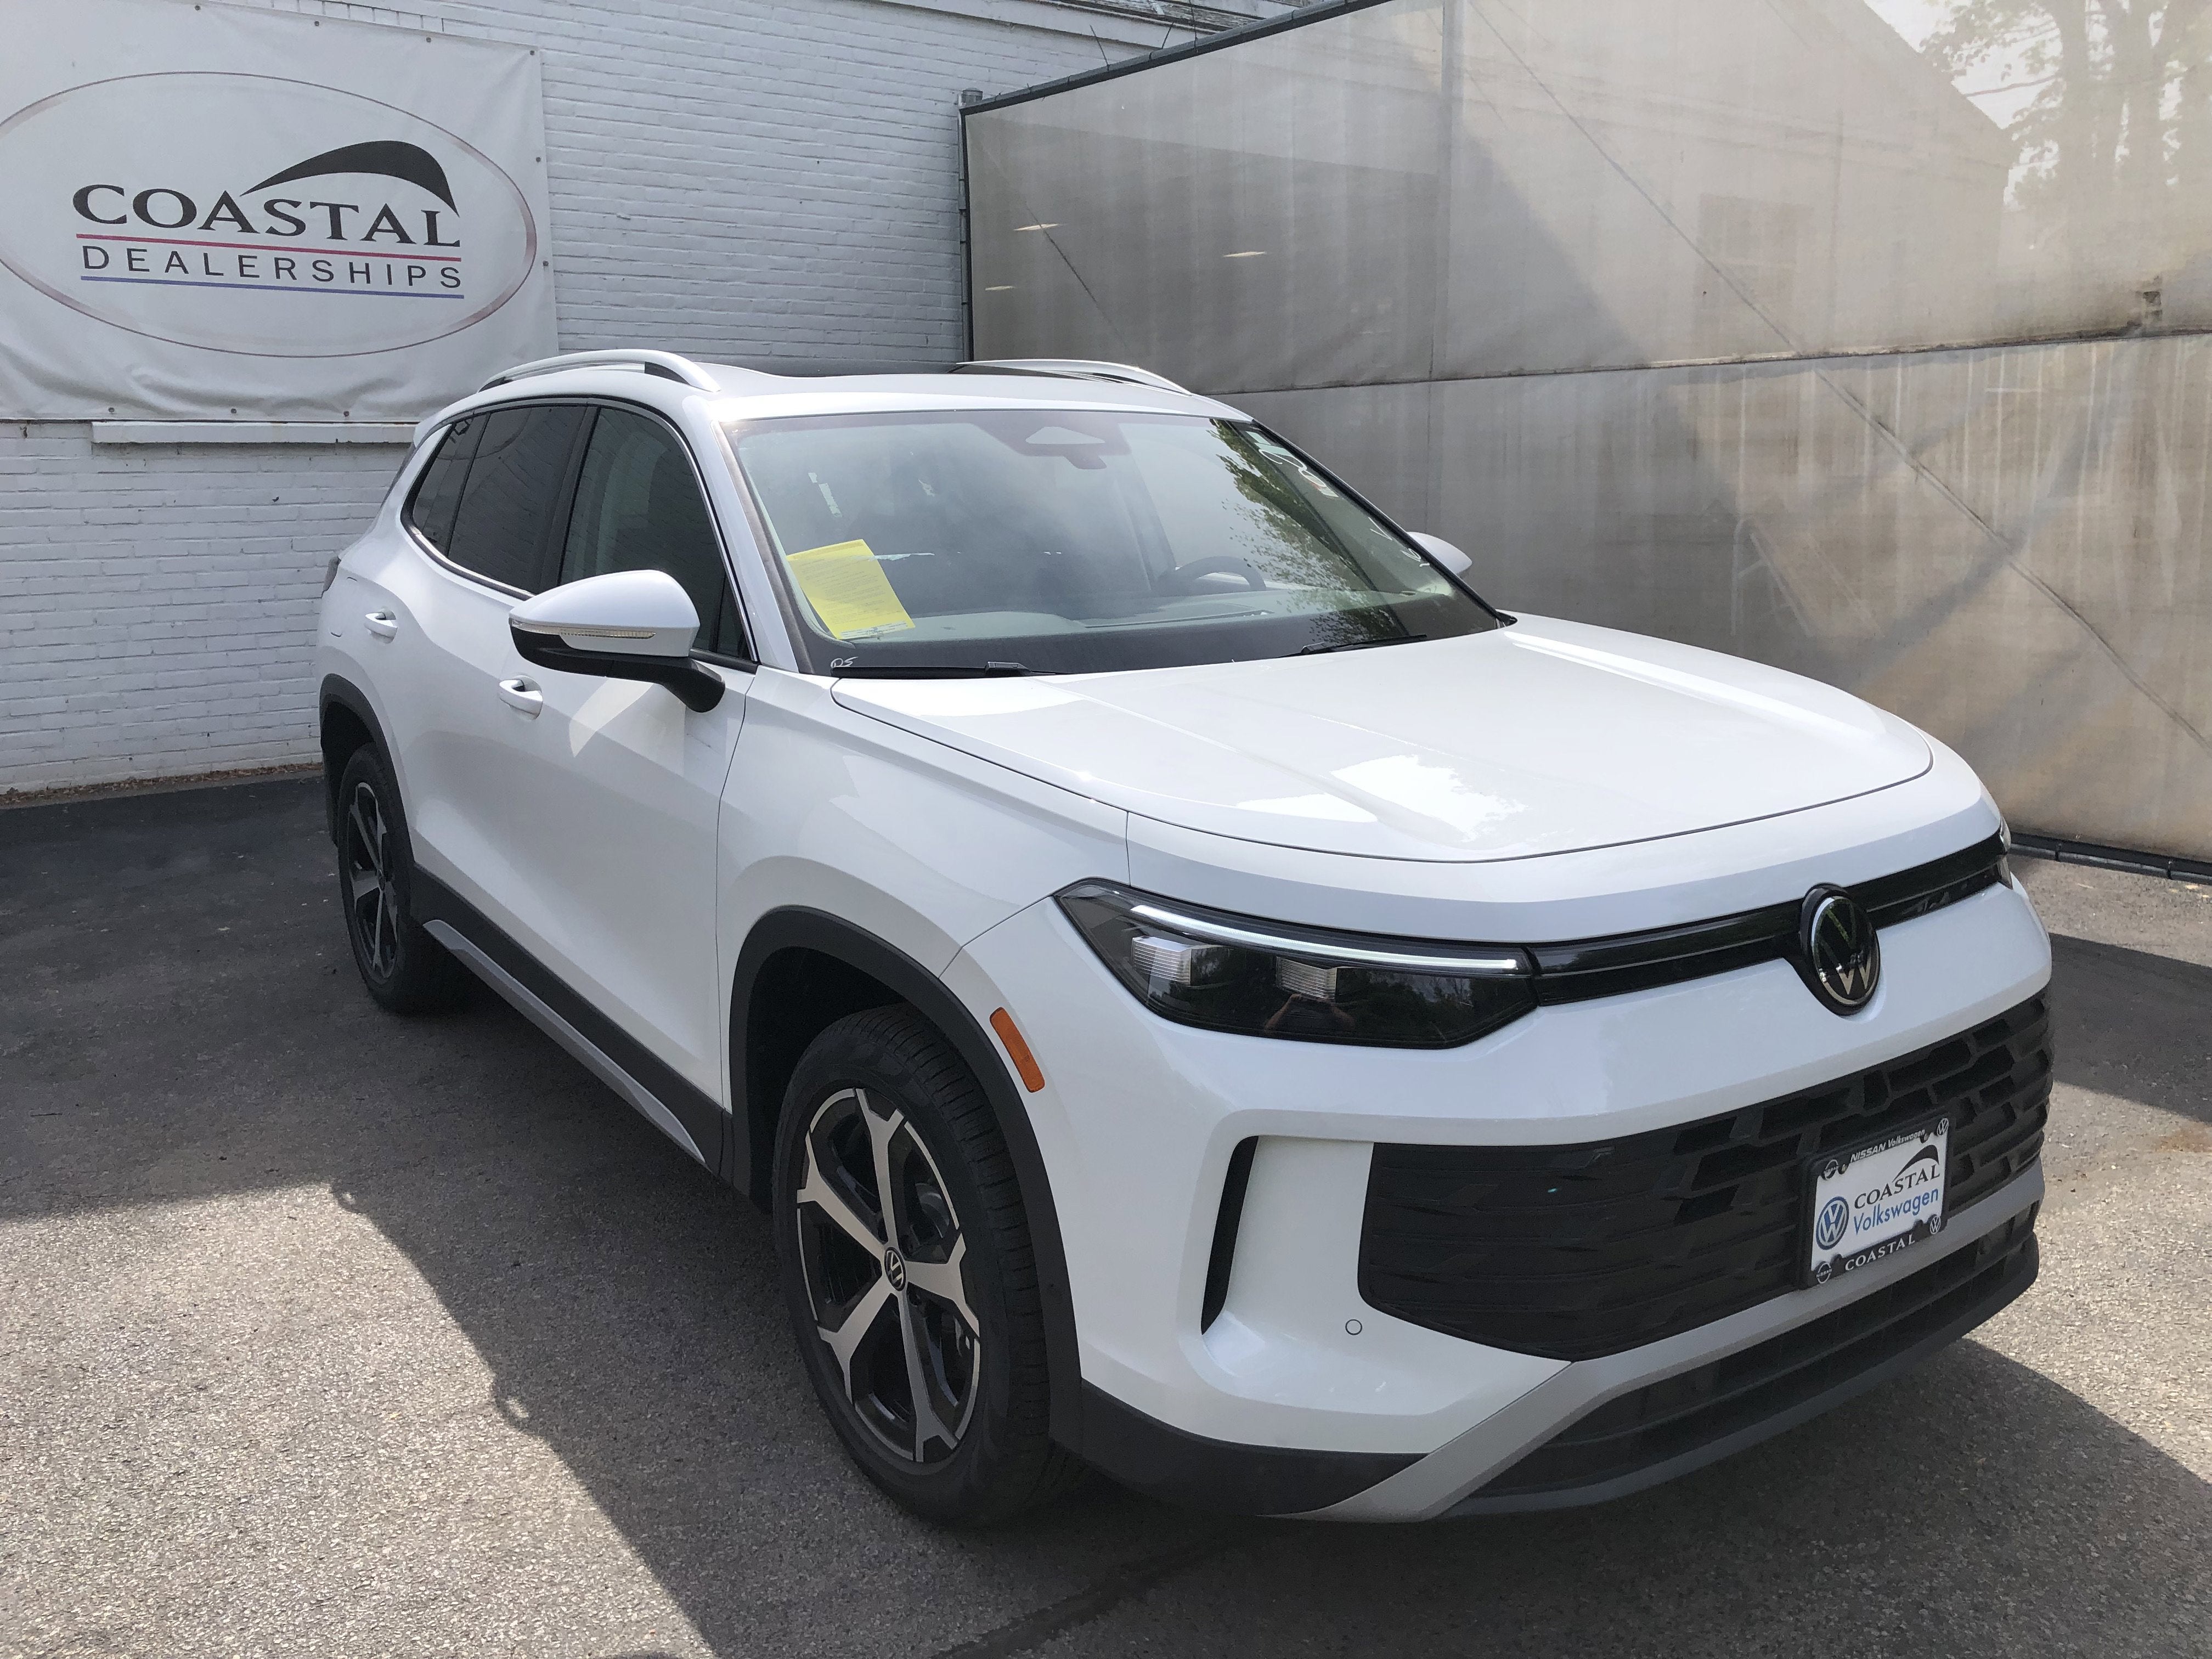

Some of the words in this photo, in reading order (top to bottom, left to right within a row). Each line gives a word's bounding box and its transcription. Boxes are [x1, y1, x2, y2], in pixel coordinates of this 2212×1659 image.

[72, 184, 461, 248] COASTAL
[82, 245, 462, 289] DEALERSHIPS
[1850, 1142, 1886, 1163] NISSAN
[1887, 1129, 1926, 1148] Volkswagen
[1854, 1164, 1940, 1210] COASTAL
[1853, 1188, 1939, 1235] Volkswagen
[1845, 1234, 1915, 1271] COASTAL
